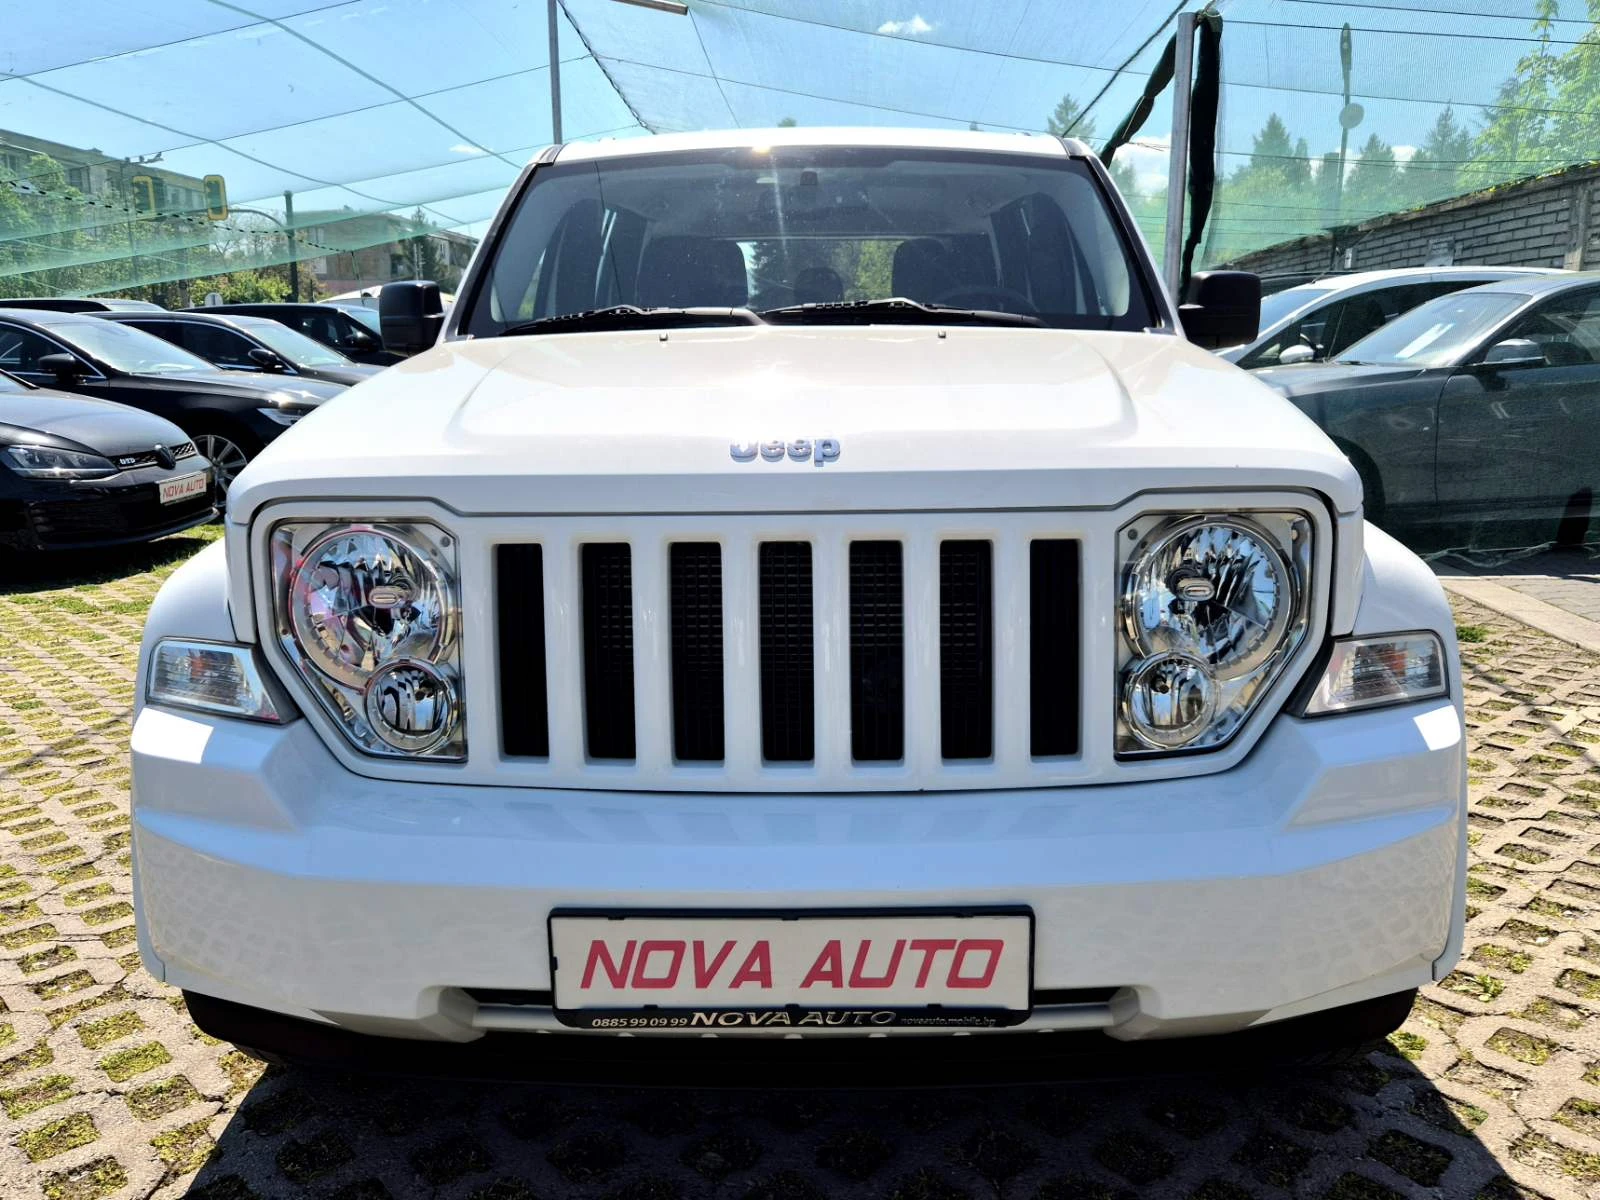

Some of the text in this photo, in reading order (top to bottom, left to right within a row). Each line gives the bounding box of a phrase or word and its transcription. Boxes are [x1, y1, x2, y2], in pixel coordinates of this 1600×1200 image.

[730, 438, 840, 467] Jeep
[163, 479, 204, 499] NOVA AUTO
[580, 939, 1004, 989] NOVA AUTO
[592, 1018, 627, 1027] 0885
[630, 1018, 647, 1027] 99
[650, 1017, 667, 1026] 09
[670, 1017, 688, 1026] 99
[690, 1012, 791, 1026] NOVA
[798, 1011, 896, 1025] AUTO
